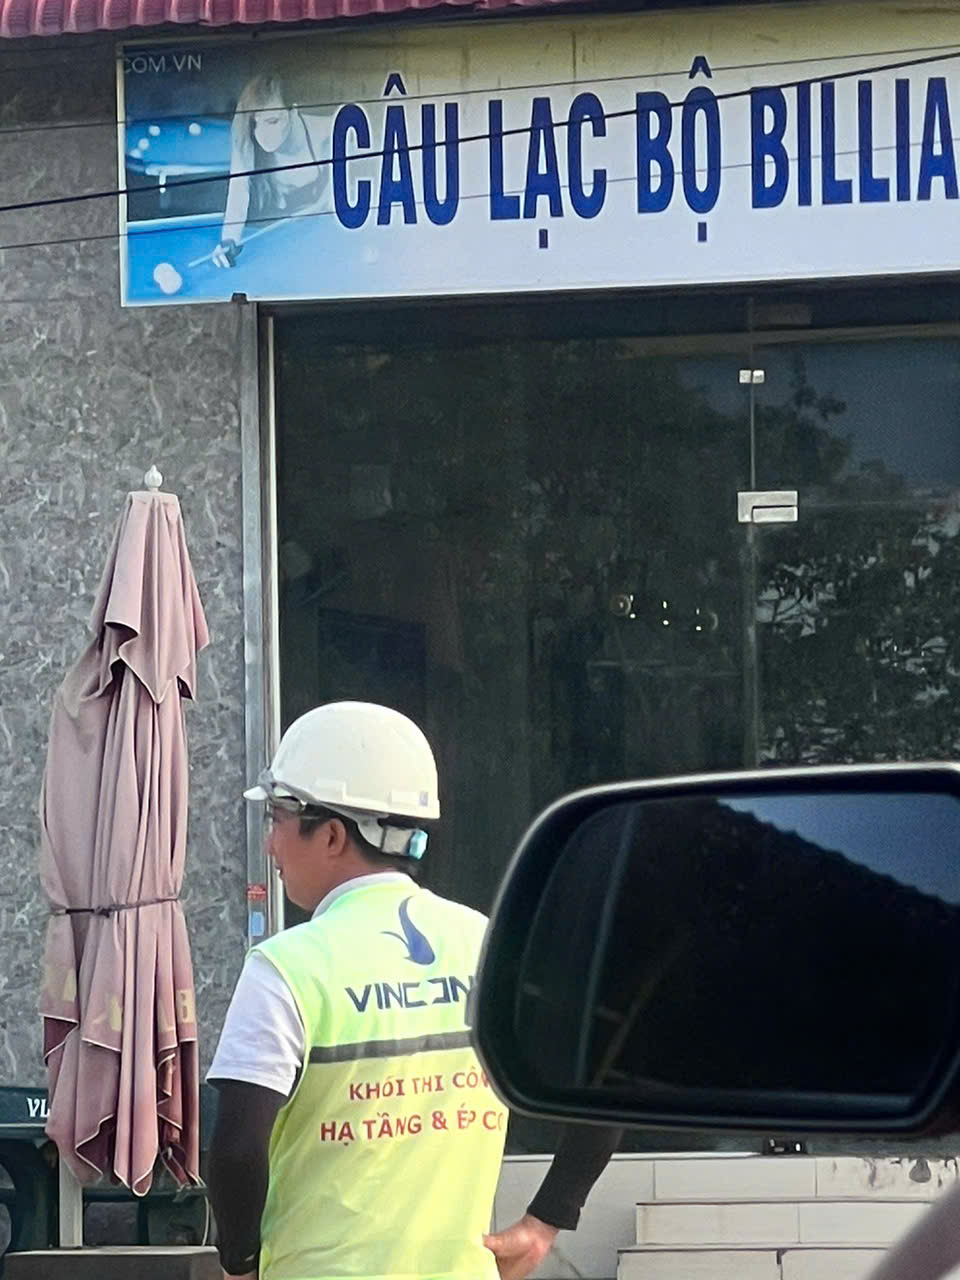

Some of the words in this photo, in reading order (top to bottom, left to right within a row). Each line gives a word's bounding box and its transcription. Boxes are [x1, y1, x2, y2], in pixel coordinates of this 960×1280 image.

[331, 72, 462, 231] CÂU
[489, 90, 608, 250] LẠC
[635, 55, 722, 244] BỘ
[749, 77, 960, 209] BILLIA
[412, 1075, 445, 1095] THI
[320, 1120, 355, 1146] HẠ
[362, 1112, 422, 1140] TẦNG
[431, 1109, 449, 1130] &
